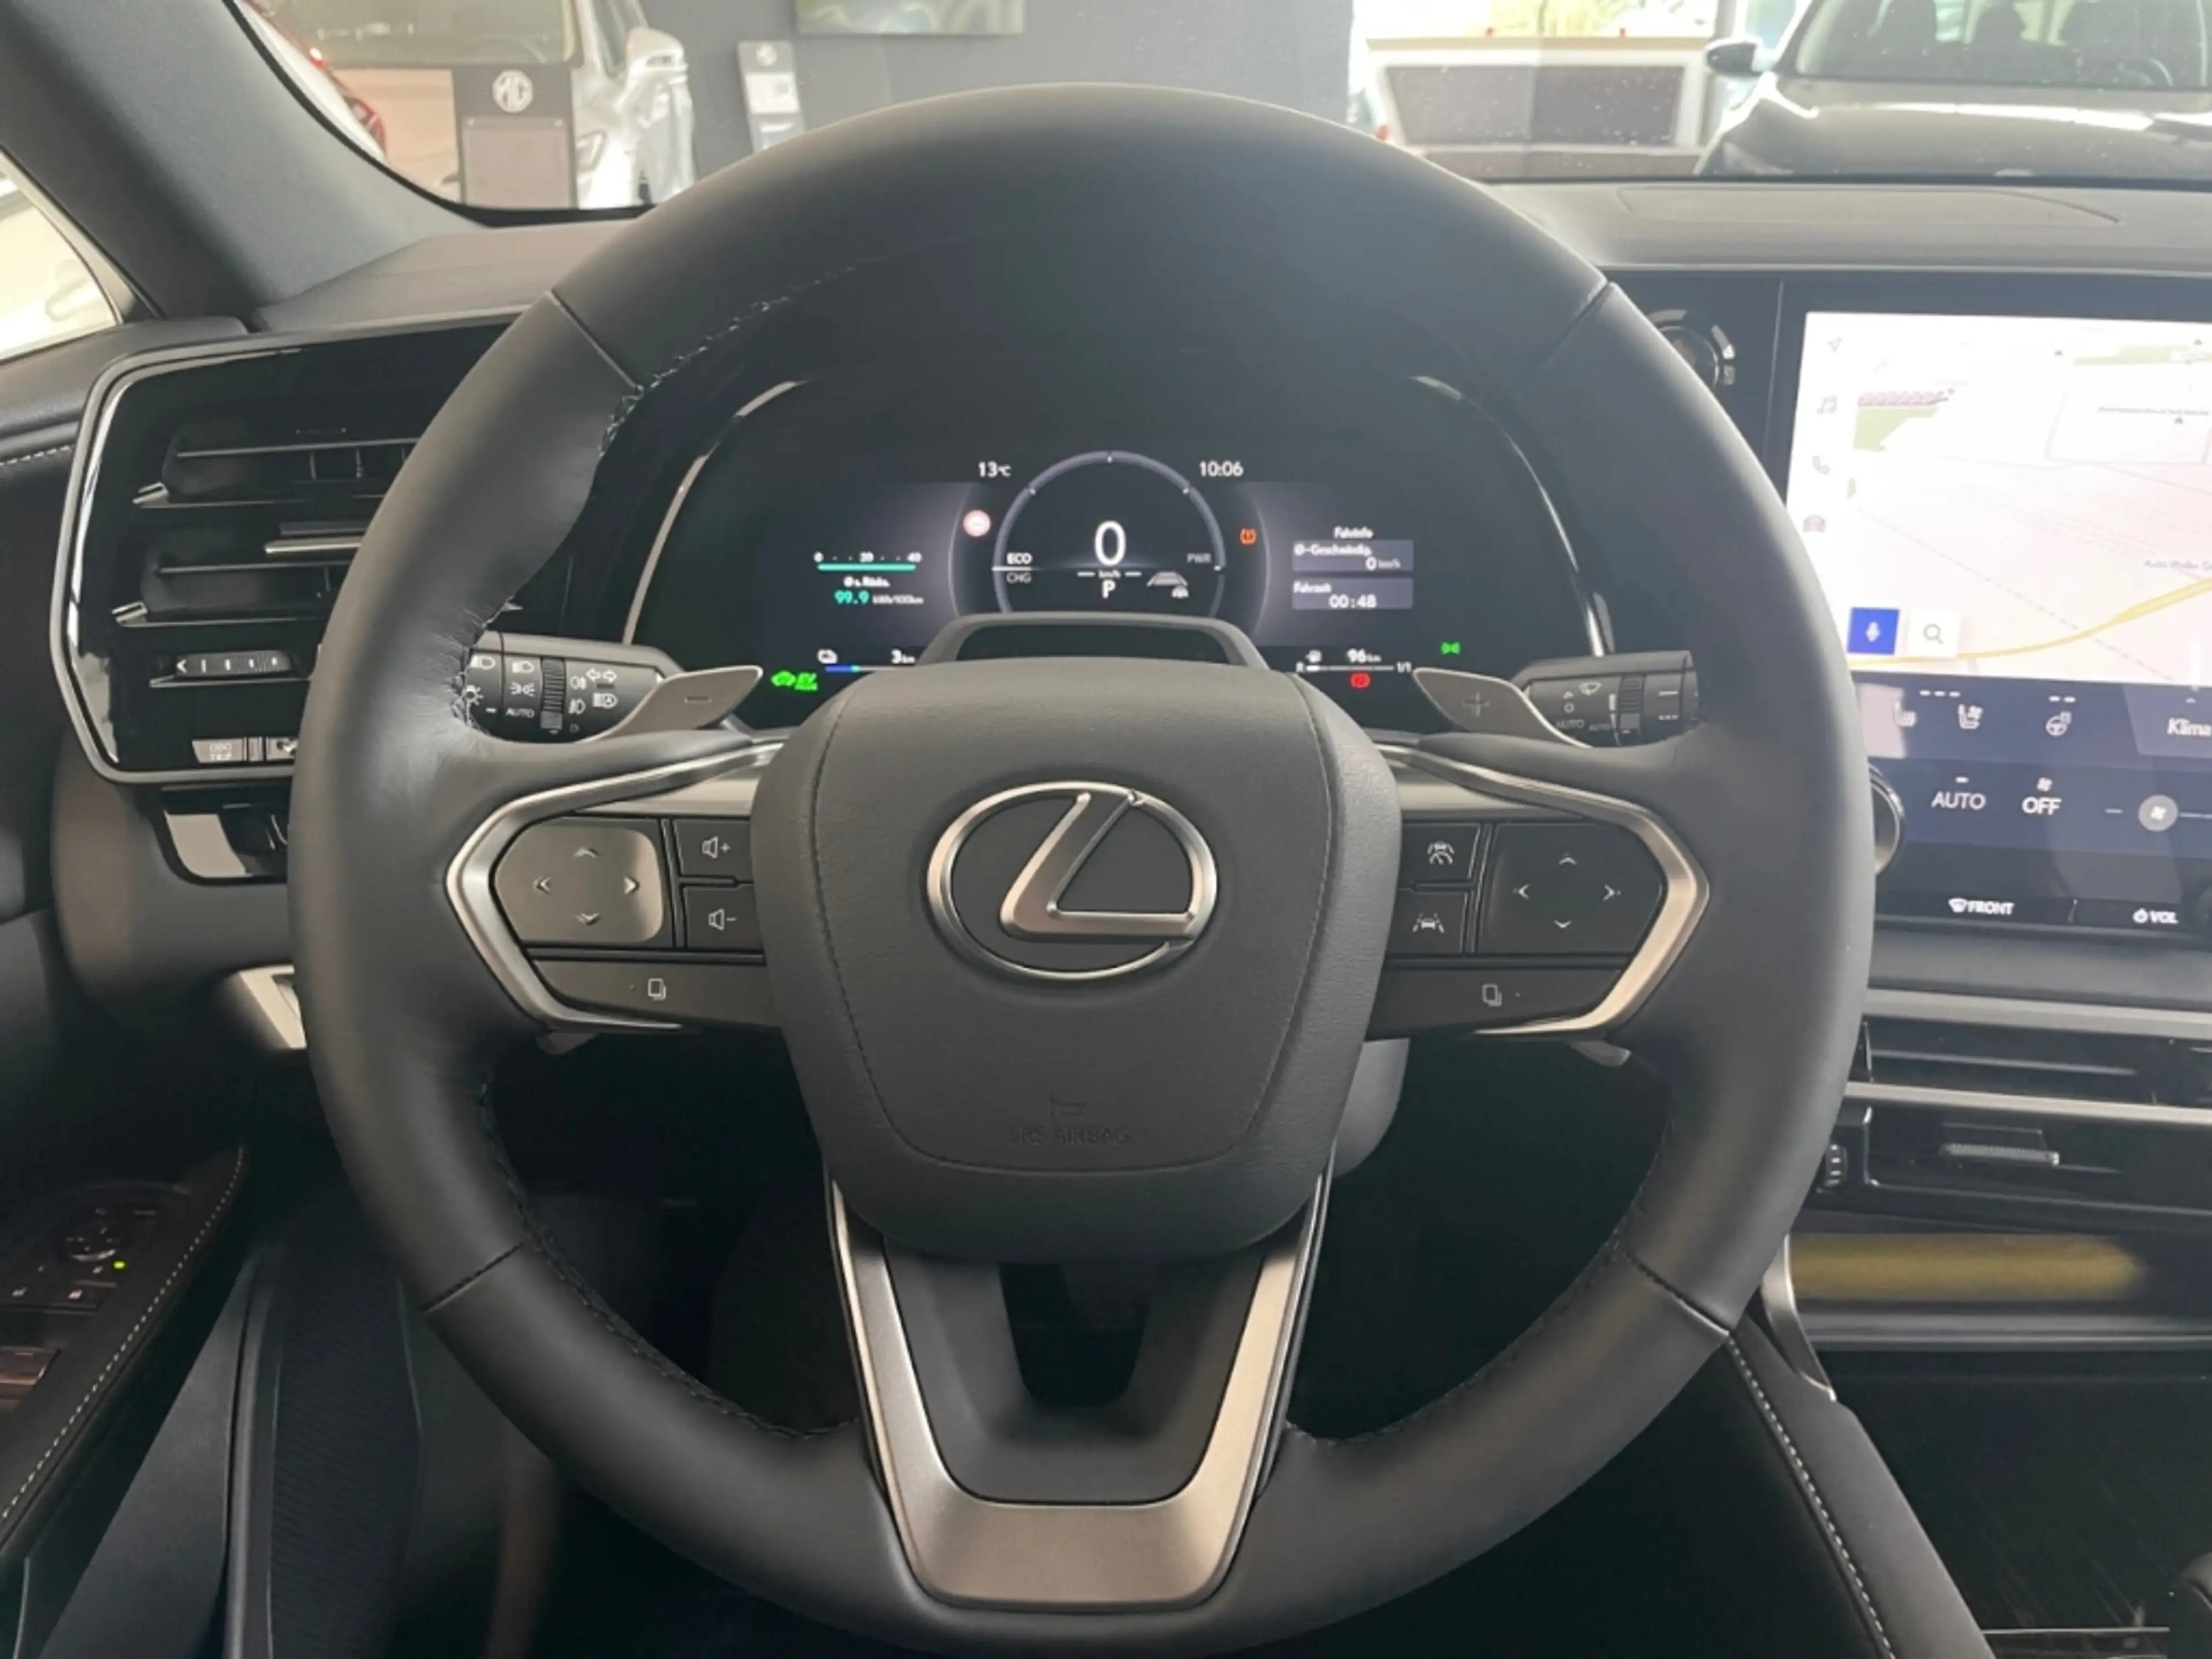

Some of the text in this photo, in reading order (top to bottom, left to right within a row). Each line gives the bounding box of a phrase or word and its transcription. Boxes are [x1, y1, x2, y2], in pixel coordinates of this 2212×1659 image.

[1199, 460, 1244, 478] 10:06
[1094, 520, 1126, 566] 0
[907, 551, 922, 563] 40
[1006, 553, 1033, 565] ECO
[1187, 553, 1211, 563] PWR
[1365, 556, 1377, 571] 0
[1006, 573, 1031, 583] CHG
[1101, 579, 1116, 599] P
[834, 590, 869, 604] 99.9
[1329, 594, 1377, 608] 00:48
[505, 707, 535, 718] AUTO
[2166, 717, 2212, 737] Klima
[1930, 791, 1987, 810] AUTO
[2021, 796, 2062, 816] OFF
[1967, 900, 2014, 915] FRONT
[2148, 910, 2180, 925] VOL
[1009, 1124, 1131, 1145] SRS AIRBAG
